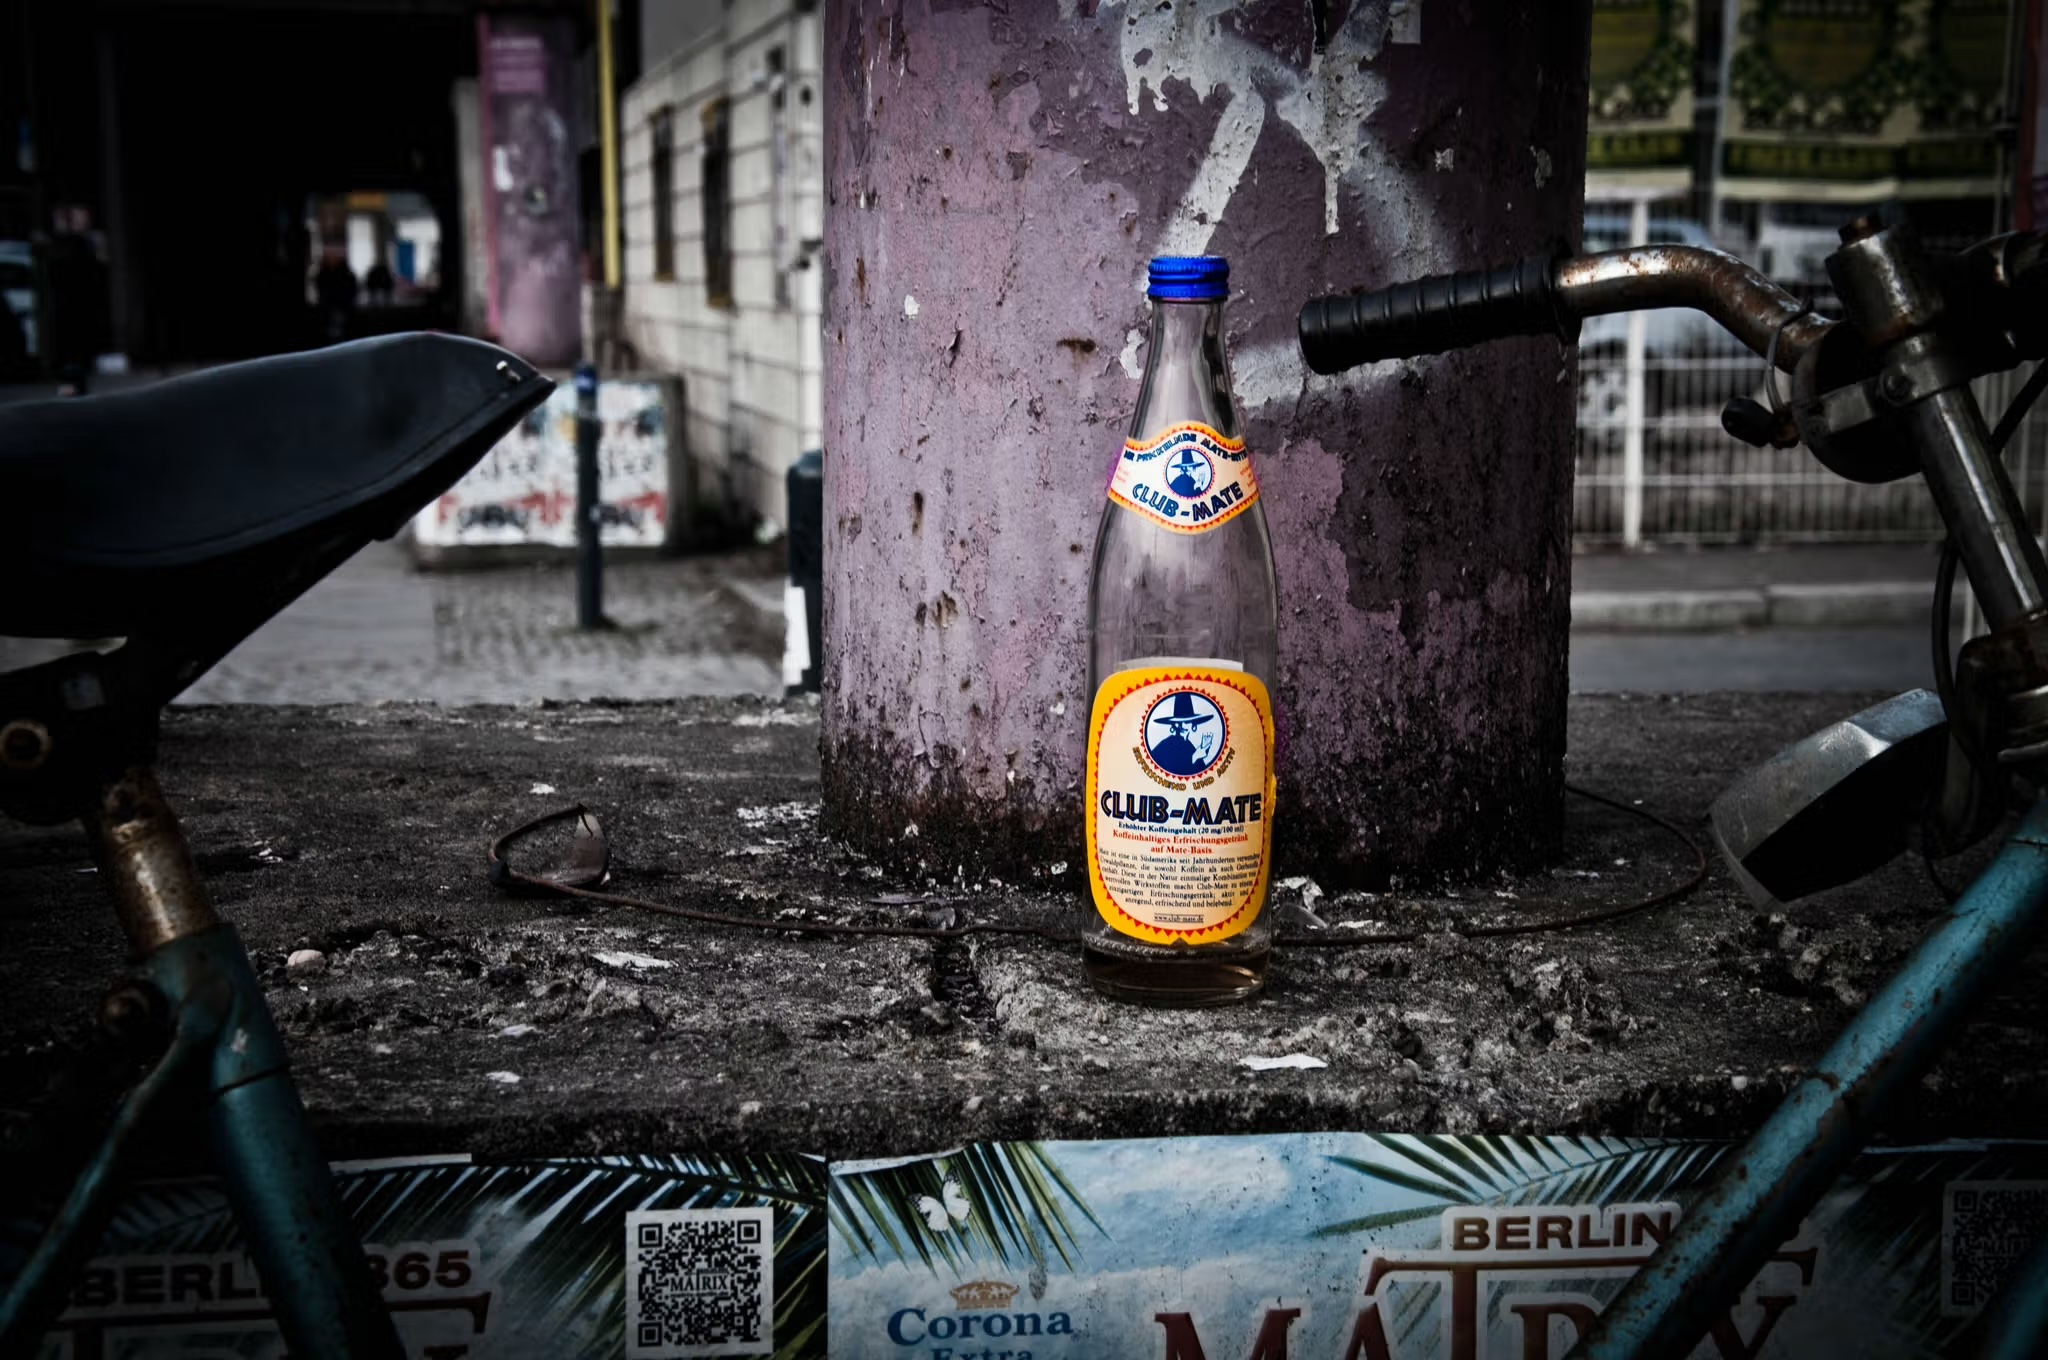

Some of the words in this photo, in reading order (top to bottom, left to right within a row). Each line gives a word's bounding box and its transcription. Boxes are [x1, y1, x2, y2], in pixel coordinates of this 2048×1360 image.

[1192, 776, 1215, 790] UND
[1100, 790, 1262, 825] CLUB-MATE
[1118, 821, 1147, 832] Erhöhter
[1148, 825, 1197, 835] Koffeingehalt
[1211, 825, 1233, 835] mg/100
[1113, 829, 1171, 844] Koffeinhaltiges
[1173, 833, 1249, 845] Erfrischungsgetränk
[1140, 855, 1177, 863] Südamerika
[1193, 856, 1235, 865] Jahrhunderten
[1121, 869, 1136, 878] Diese
[1147, 872, 1157, 880] der
[1160, 873, 1178, 881] Natur
[1180, 874, 1210, 882] einmalige
[1181, 865, 1205, 873] Koffein
[1134, 880, 1170, 889] Wirkstoffen
[1197, 882, 1228, 890] Club-Mate
[1452, 1211, 1672, 1251] BERLIN
[670, 1269, 729, 1291] MATRIX
[887, 1307, 1074, 1346] Corona
